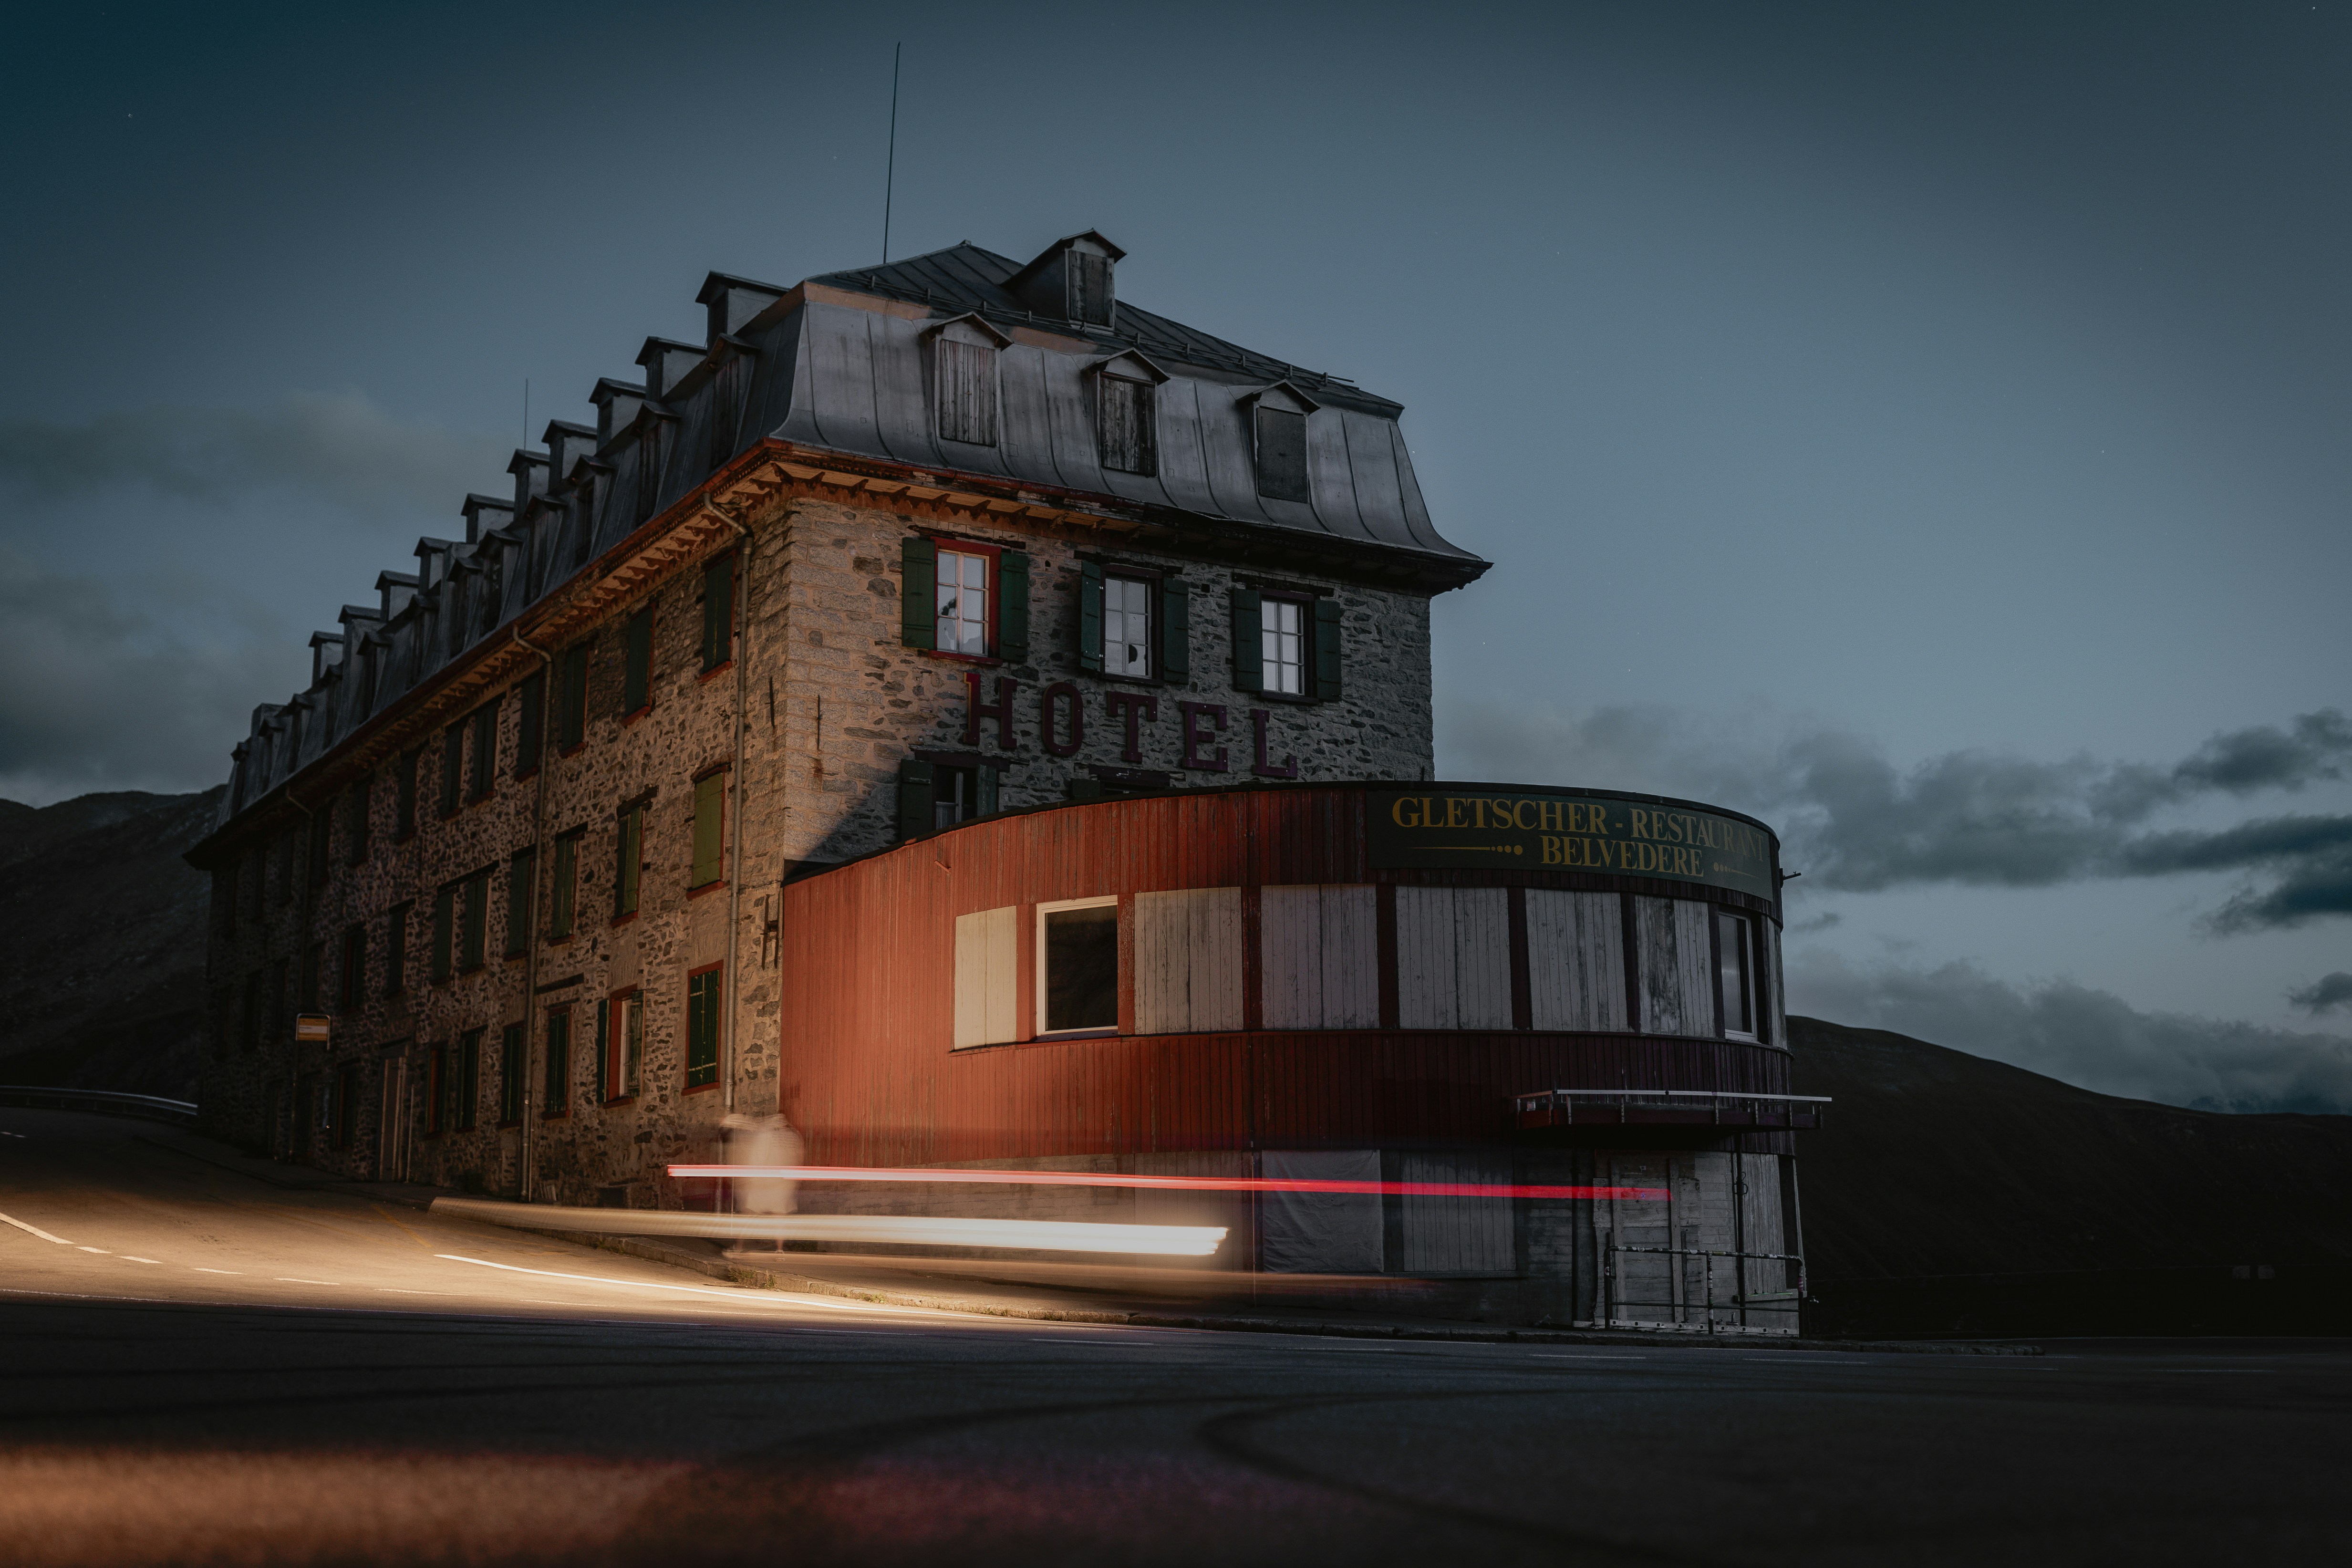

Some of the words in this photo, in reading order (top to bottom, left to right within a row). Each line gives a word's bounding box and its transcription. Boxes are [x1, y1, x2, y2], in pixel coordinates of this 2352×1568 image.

[963, 672, 1298, 779] HOTEL
[1392, 797, 1609, 834] GLETSCHER
[1629, 808, 1763, 862] RESTAURANT
[1540, 835, 1704, 877] BELVEDERE
